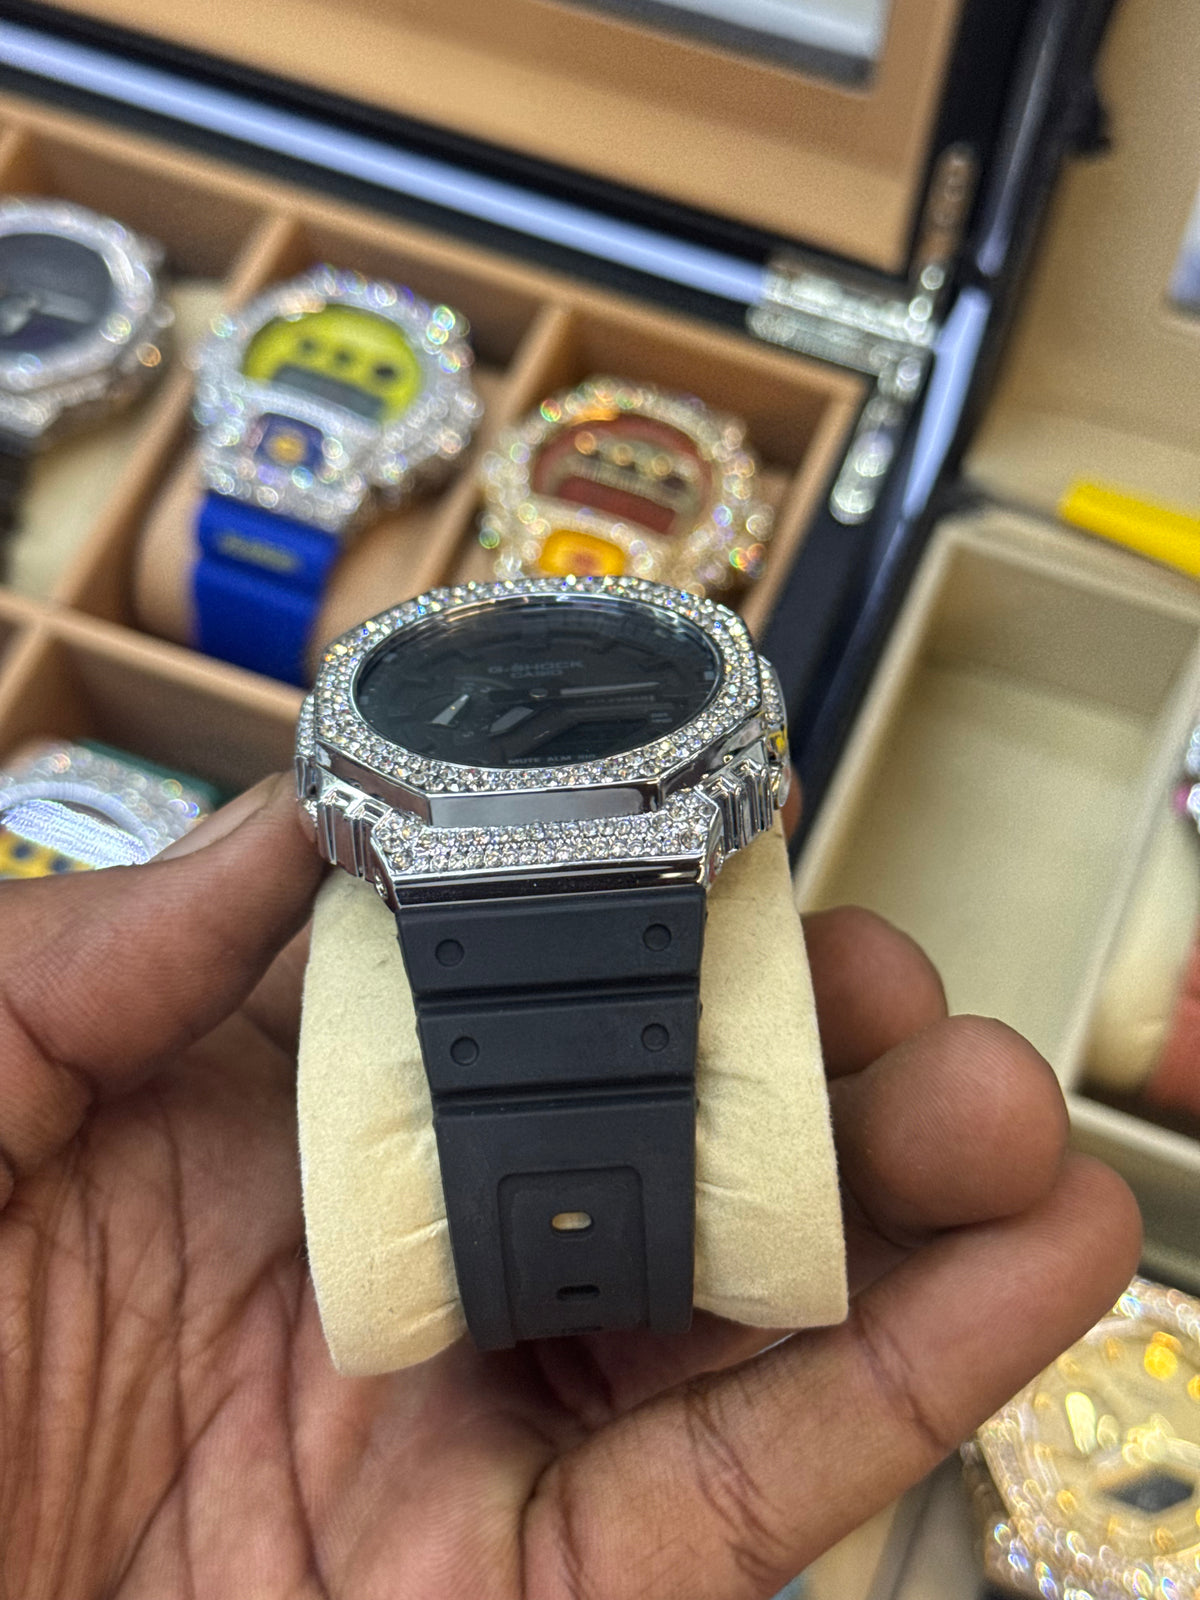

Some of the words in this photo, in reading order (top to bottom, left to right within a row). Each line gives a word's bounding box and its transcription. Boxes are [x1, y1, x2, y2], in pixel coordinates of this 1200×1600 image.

[488, 661, 584, 674] G-SHOCK
[510, 669, 564, 679] CASIO
[508, 757, 541, 765] MUTE
